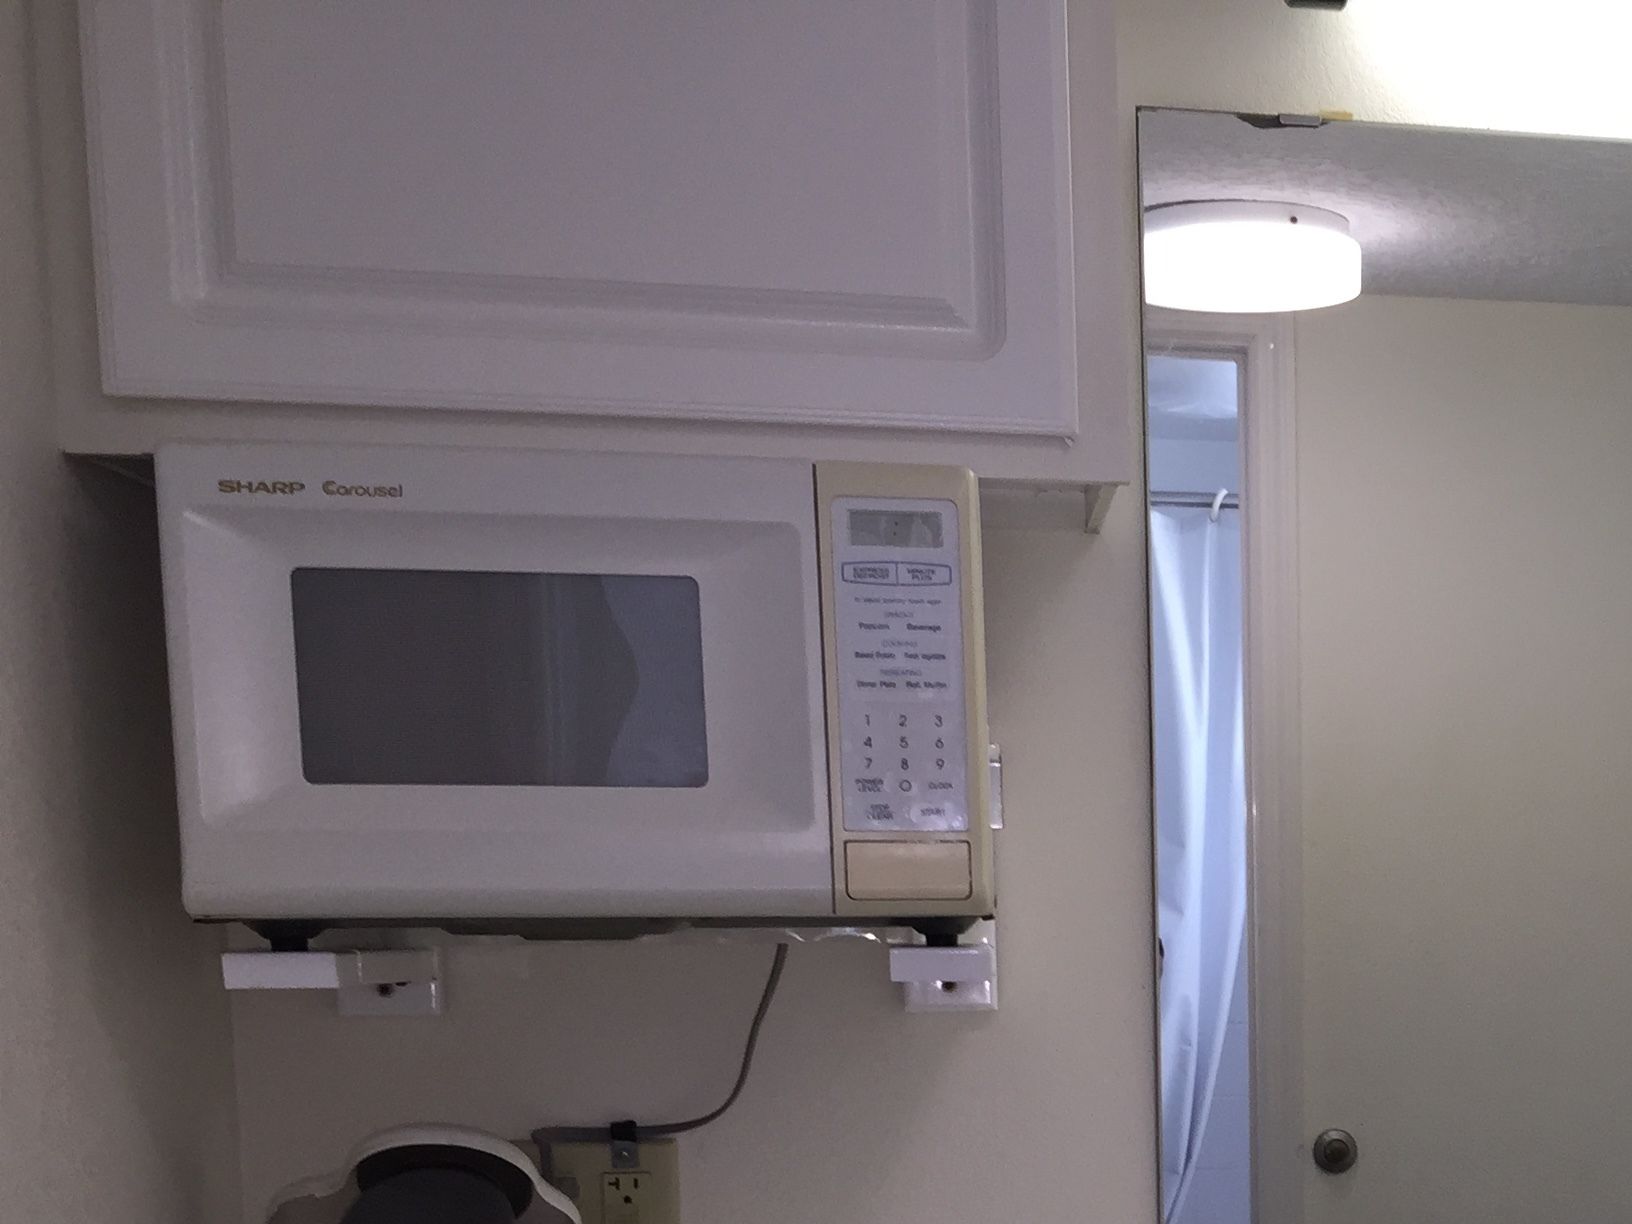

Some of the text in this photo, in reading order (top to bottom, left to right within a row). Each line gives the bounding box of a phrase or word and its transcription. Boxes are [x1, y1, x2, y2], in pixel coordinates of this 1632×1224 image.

[218, 479, 403, 497] SHARP Carousel
[864, 714, 943, 728] 1 2 3
[863, 736, 944, 749] 4 5 6
[864, 757, 945, 770] 7 8 9
